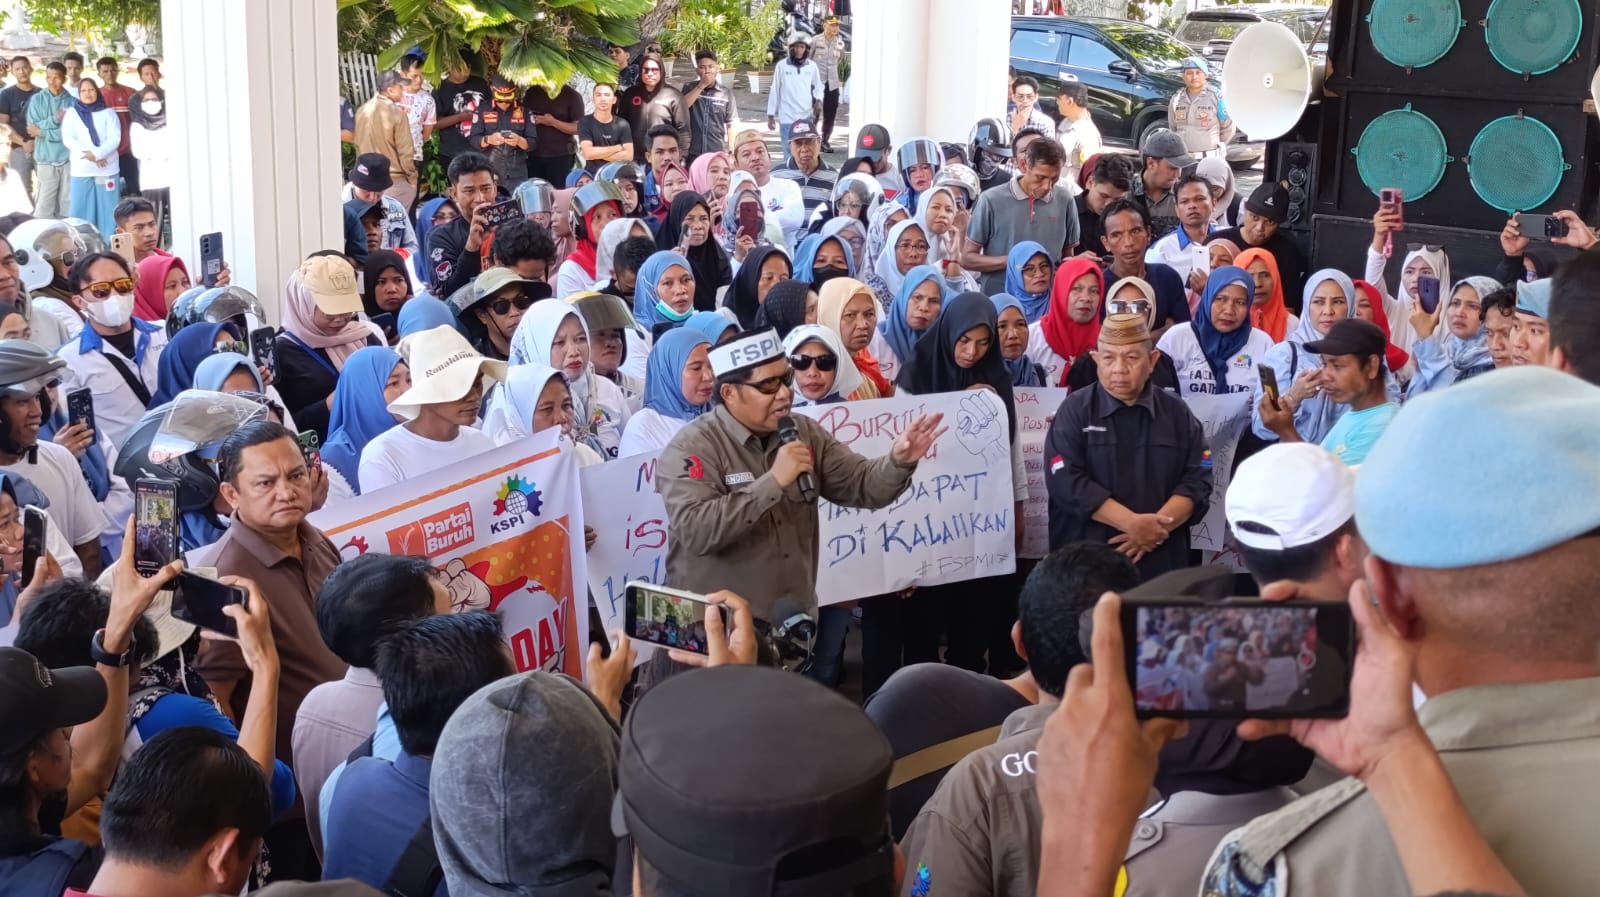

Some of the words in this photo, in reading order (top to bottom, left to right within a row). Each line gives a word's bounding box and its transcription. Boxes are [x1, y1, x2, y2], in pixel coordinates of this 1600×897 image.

[423, 508, 471, 538] Partai
[490, 514, 525, 534] KSPI
[426, 525, 473, 553] Buruh
[511, 596, 568, 673] DAY
